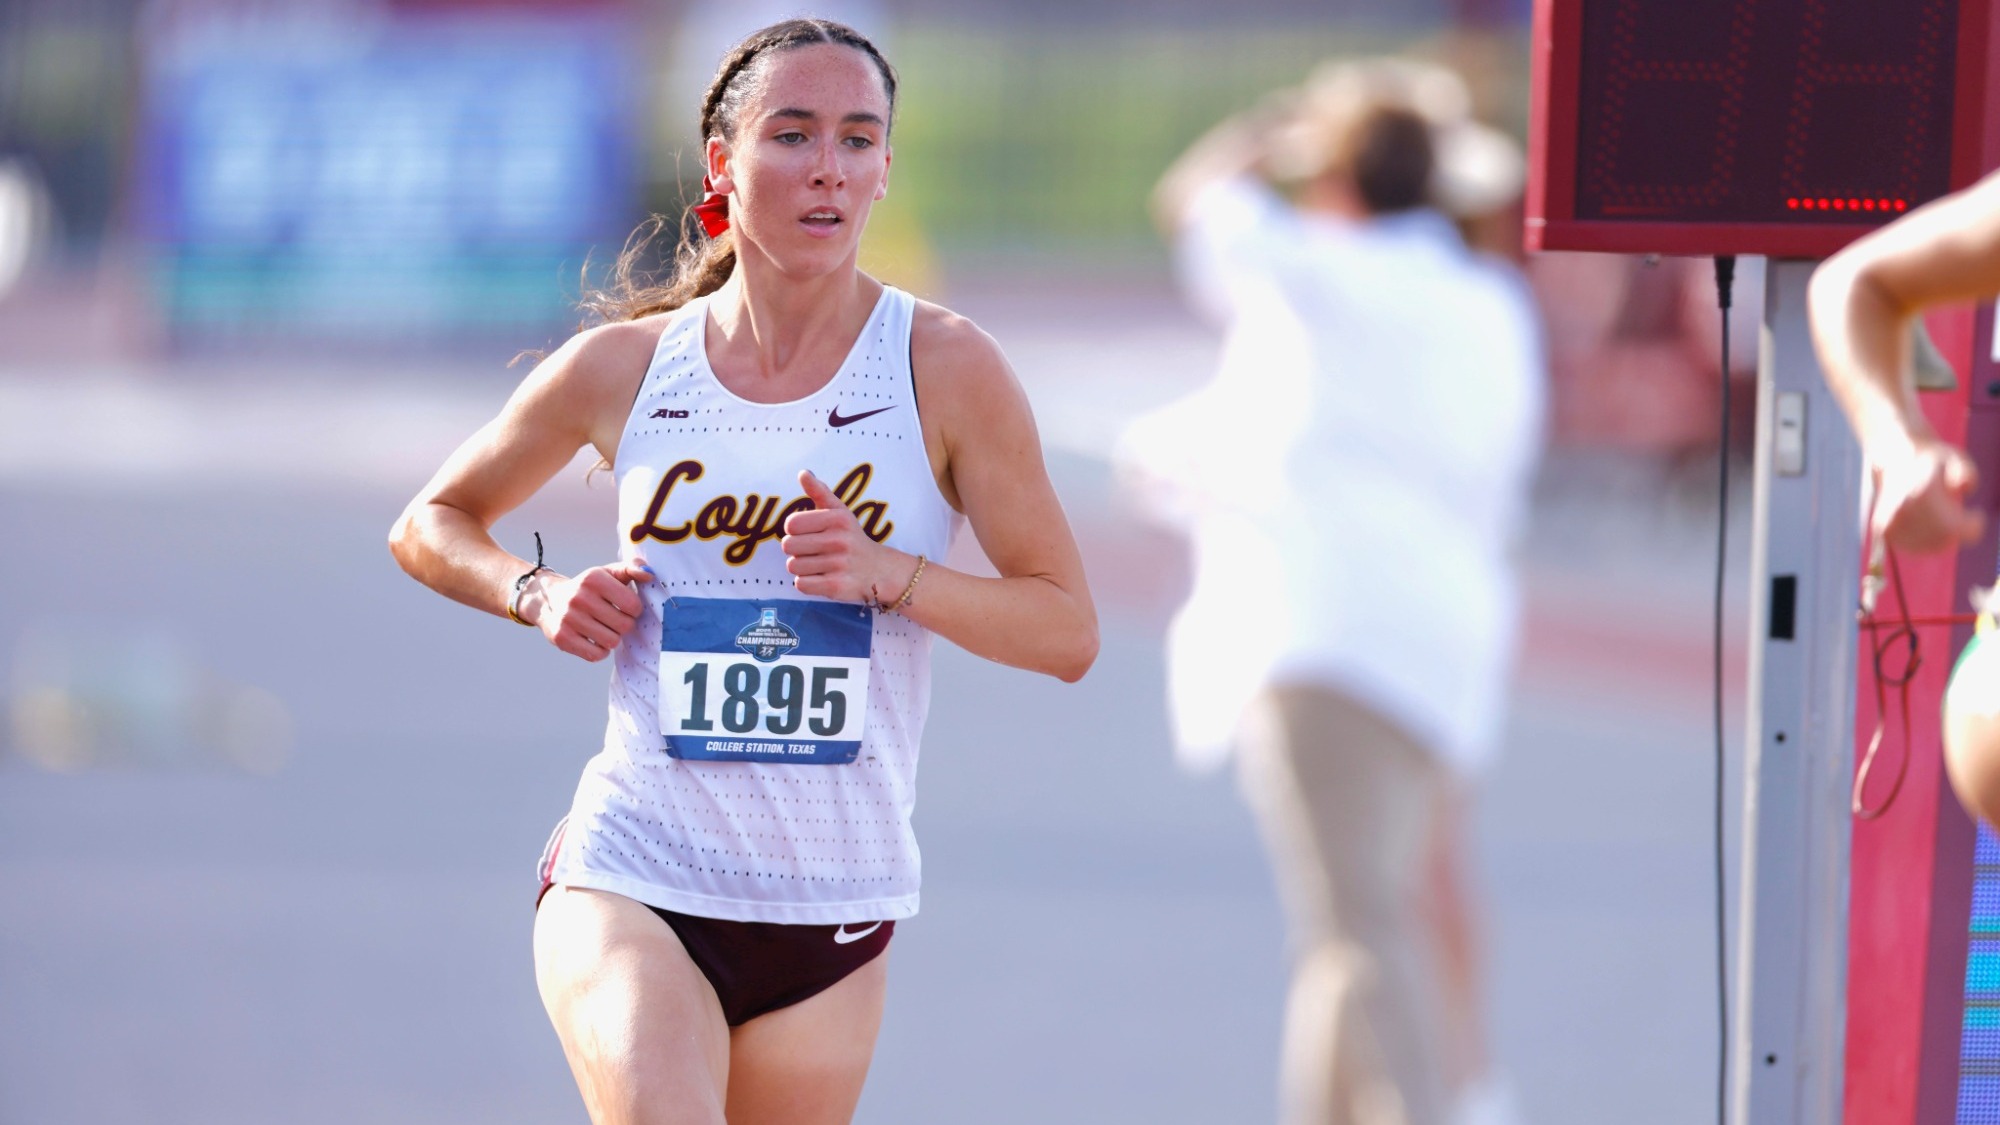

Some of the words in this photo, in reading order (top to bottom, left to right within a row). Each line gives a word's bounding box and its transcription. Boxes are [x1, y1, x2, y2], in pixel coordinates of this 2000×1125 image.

[737, 636, 798, 646] CHAMPIONSHIPS
[680, 662, 849, 737] 1895
[706, 741, 745, 752] COLLEGE
[745, 743, 785, 754] STATION,
[788, 744, 816, 754] TEXAS
